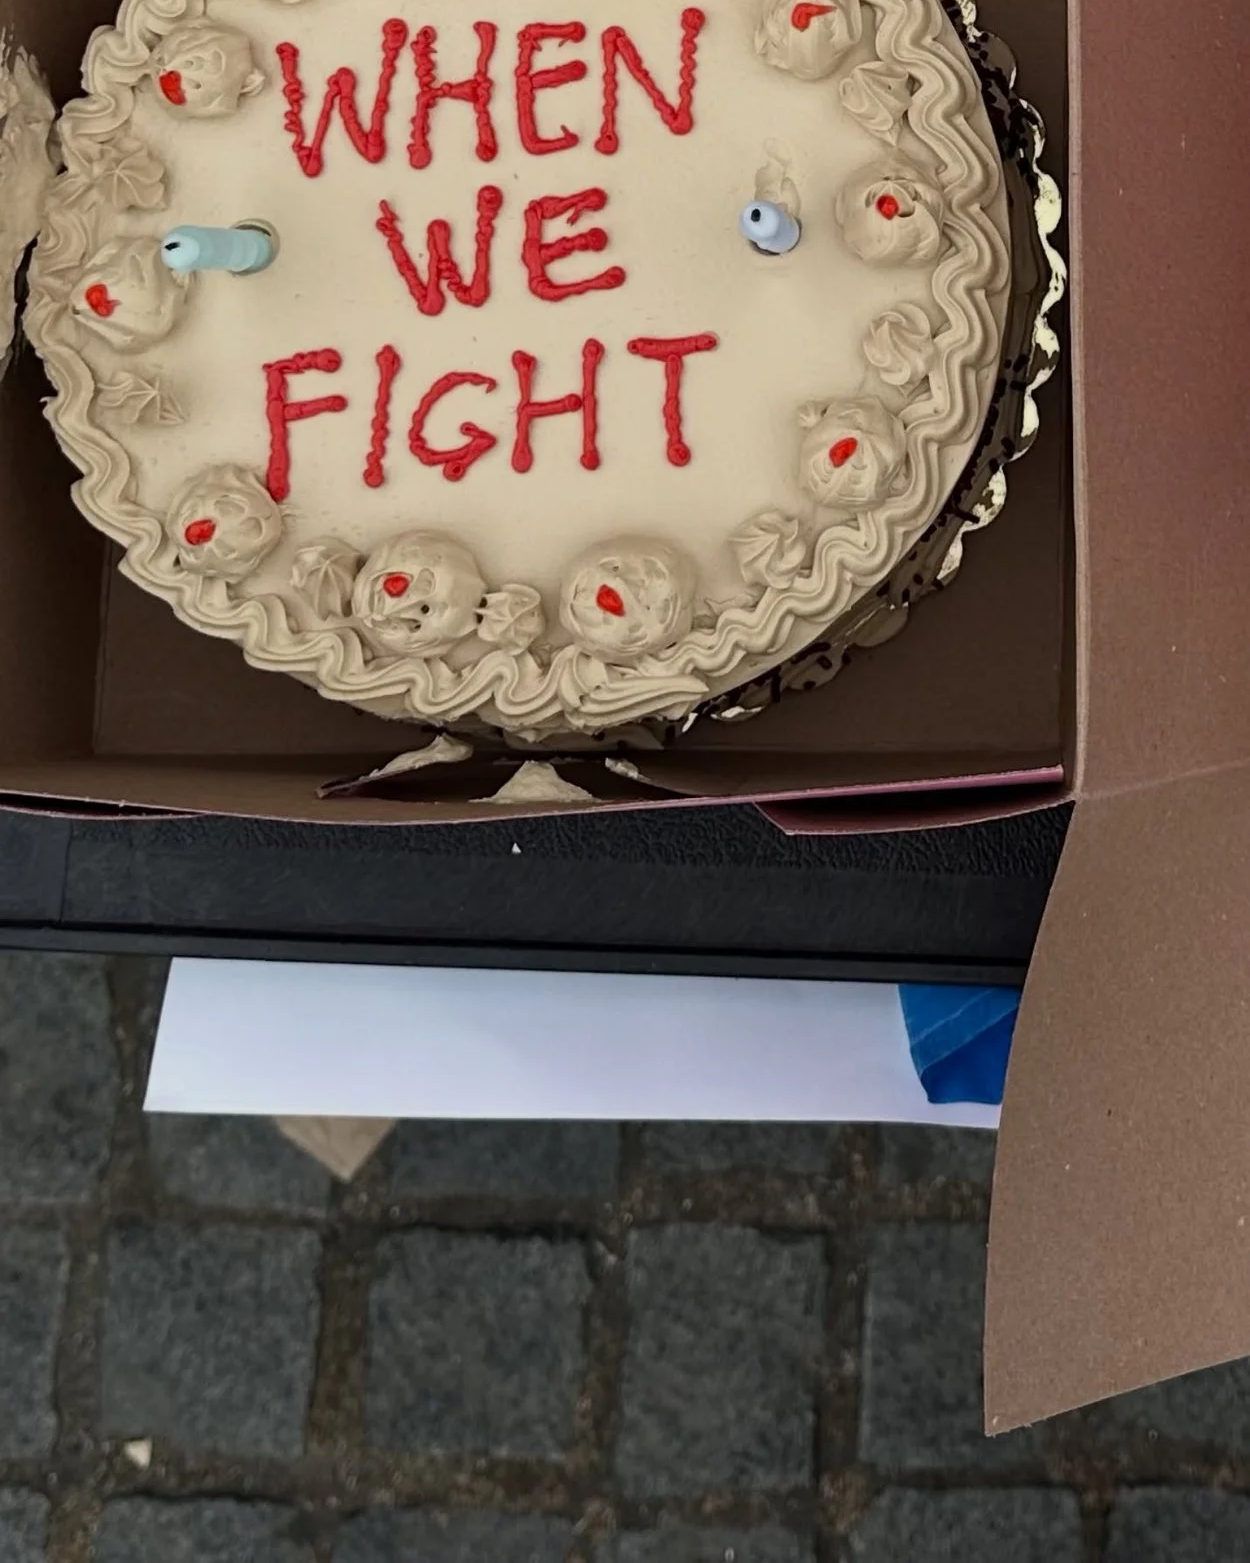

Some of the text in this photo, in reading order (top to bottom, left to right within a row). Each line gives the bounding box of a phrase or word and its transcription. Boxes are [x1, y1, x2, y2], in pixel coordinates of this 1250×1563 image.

[276, 7, 706, 178] WHEN
[376, 185, 627, 316] WE
[262, 337, 718, 503] FIGHT
